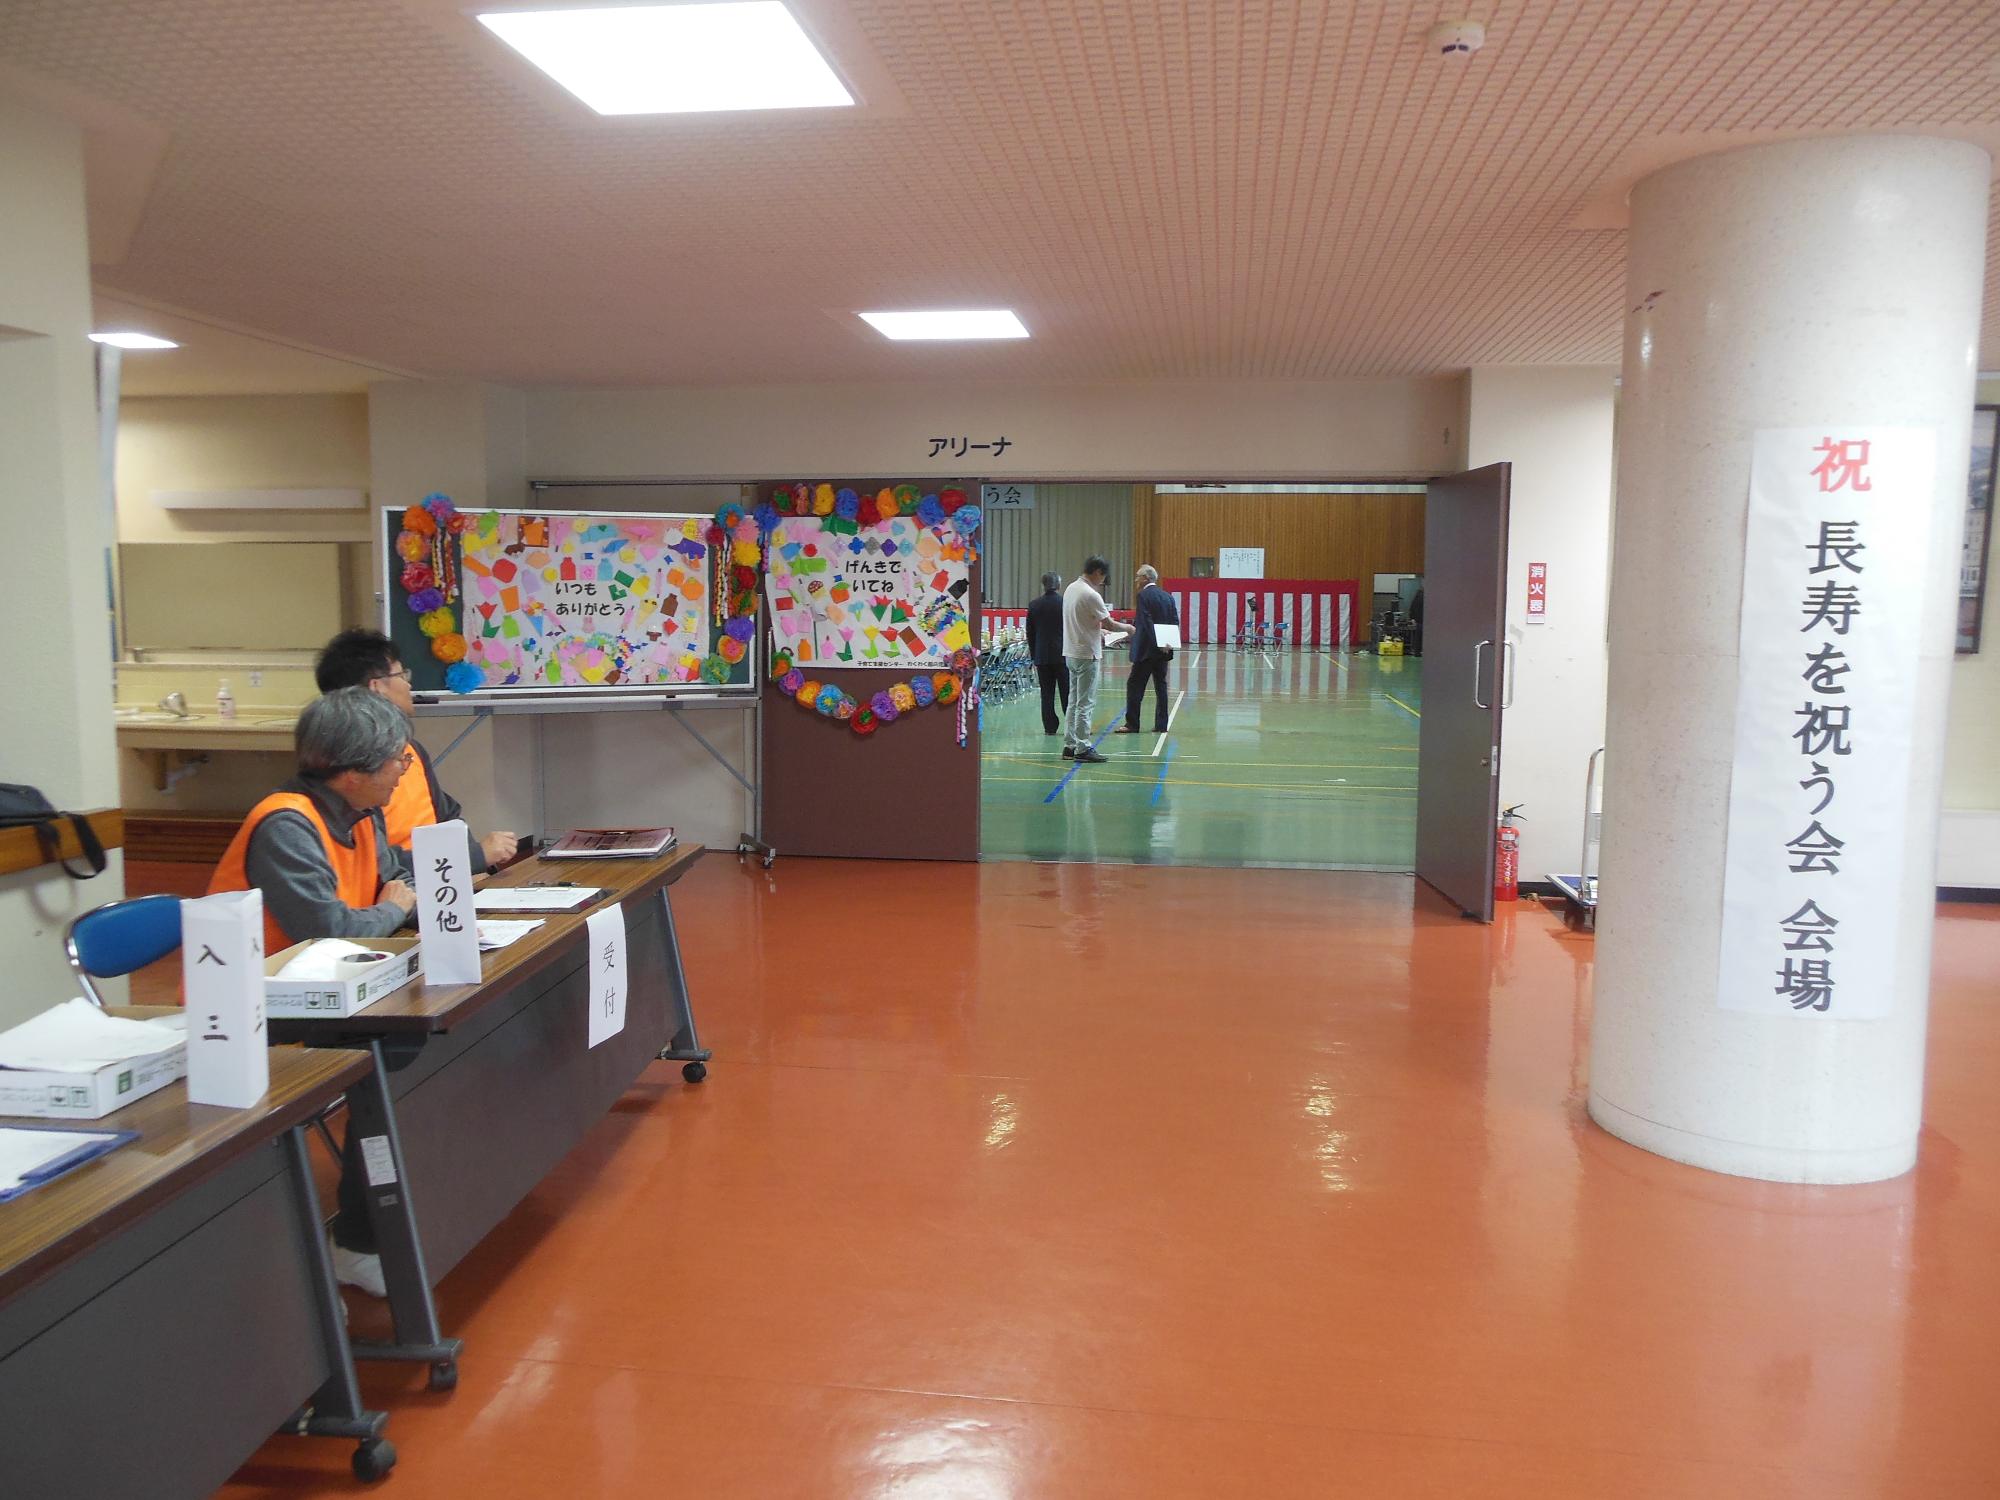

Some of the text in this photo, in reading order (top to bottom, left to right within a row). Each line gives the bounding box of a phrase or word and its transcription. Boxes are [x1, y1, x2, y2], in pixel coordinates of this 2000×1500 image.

[928, 436, 1012, 457] アリーナ
[987, 486, 1021, 505] う会
[845, 560, 901, 574] げんきで
[555, 582, 597, 596] いつも
[853, 579, 893, 593] いてね
[1529, 566, 1545, 612] 消火器
[555, 602, 625, 616] ありがとう
[1774, 436, 1872, 1013] 祝 長寿を祝う会 会場
[434, 857, 463, 933] その他
[602, 941, 616, 1019] 受付
